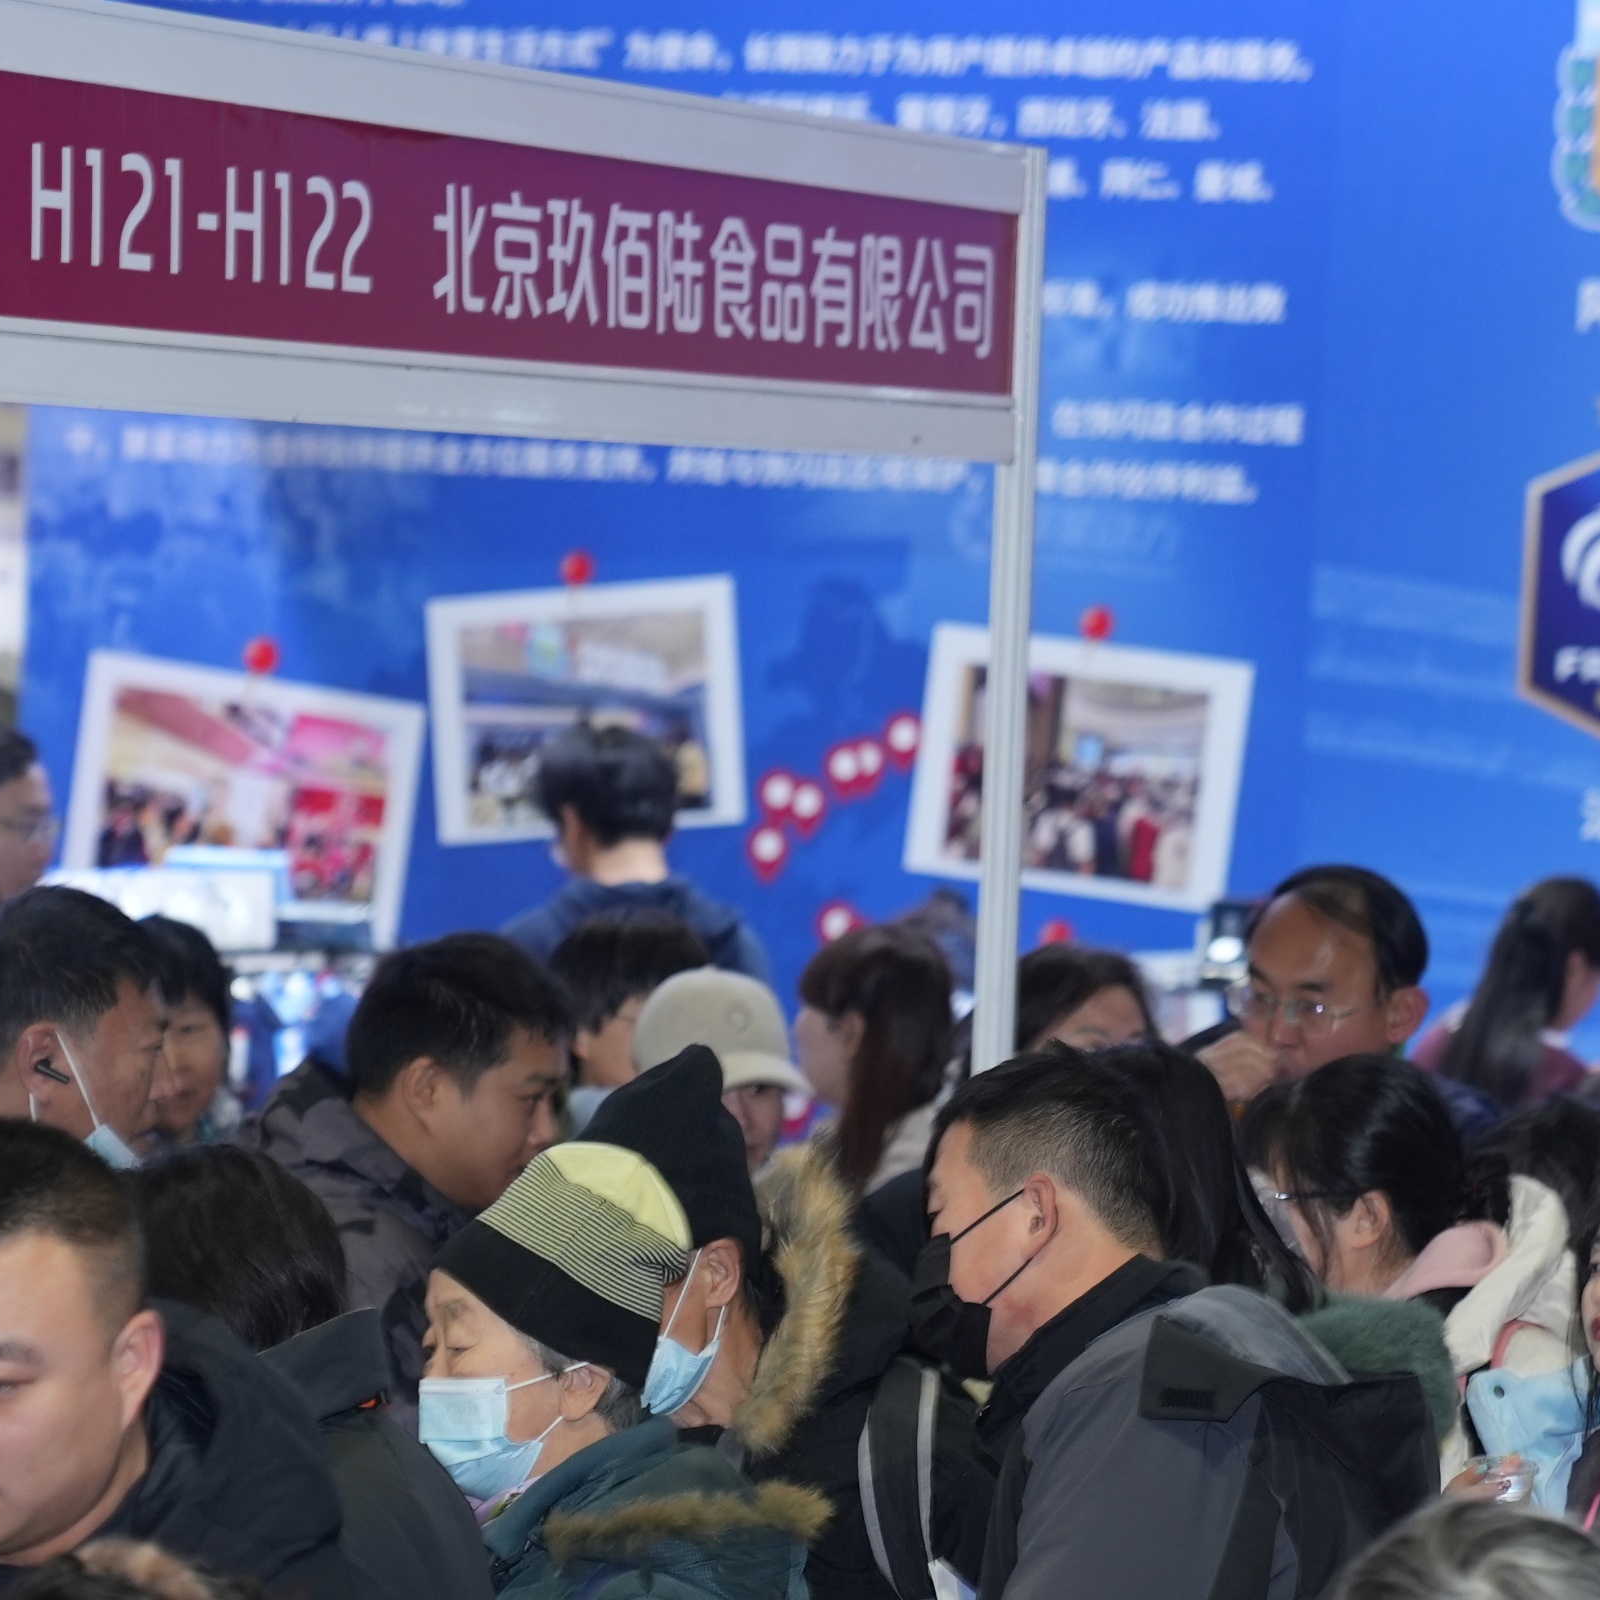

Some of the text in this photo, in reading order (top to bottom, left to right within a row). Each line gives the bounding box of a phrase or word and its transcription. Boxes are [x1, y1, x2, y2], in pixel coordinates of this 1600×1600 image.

[30, 141, 375, 294] H121-H122
[432, 182, 997, 360] 北京玖佰陆食品有限公司
